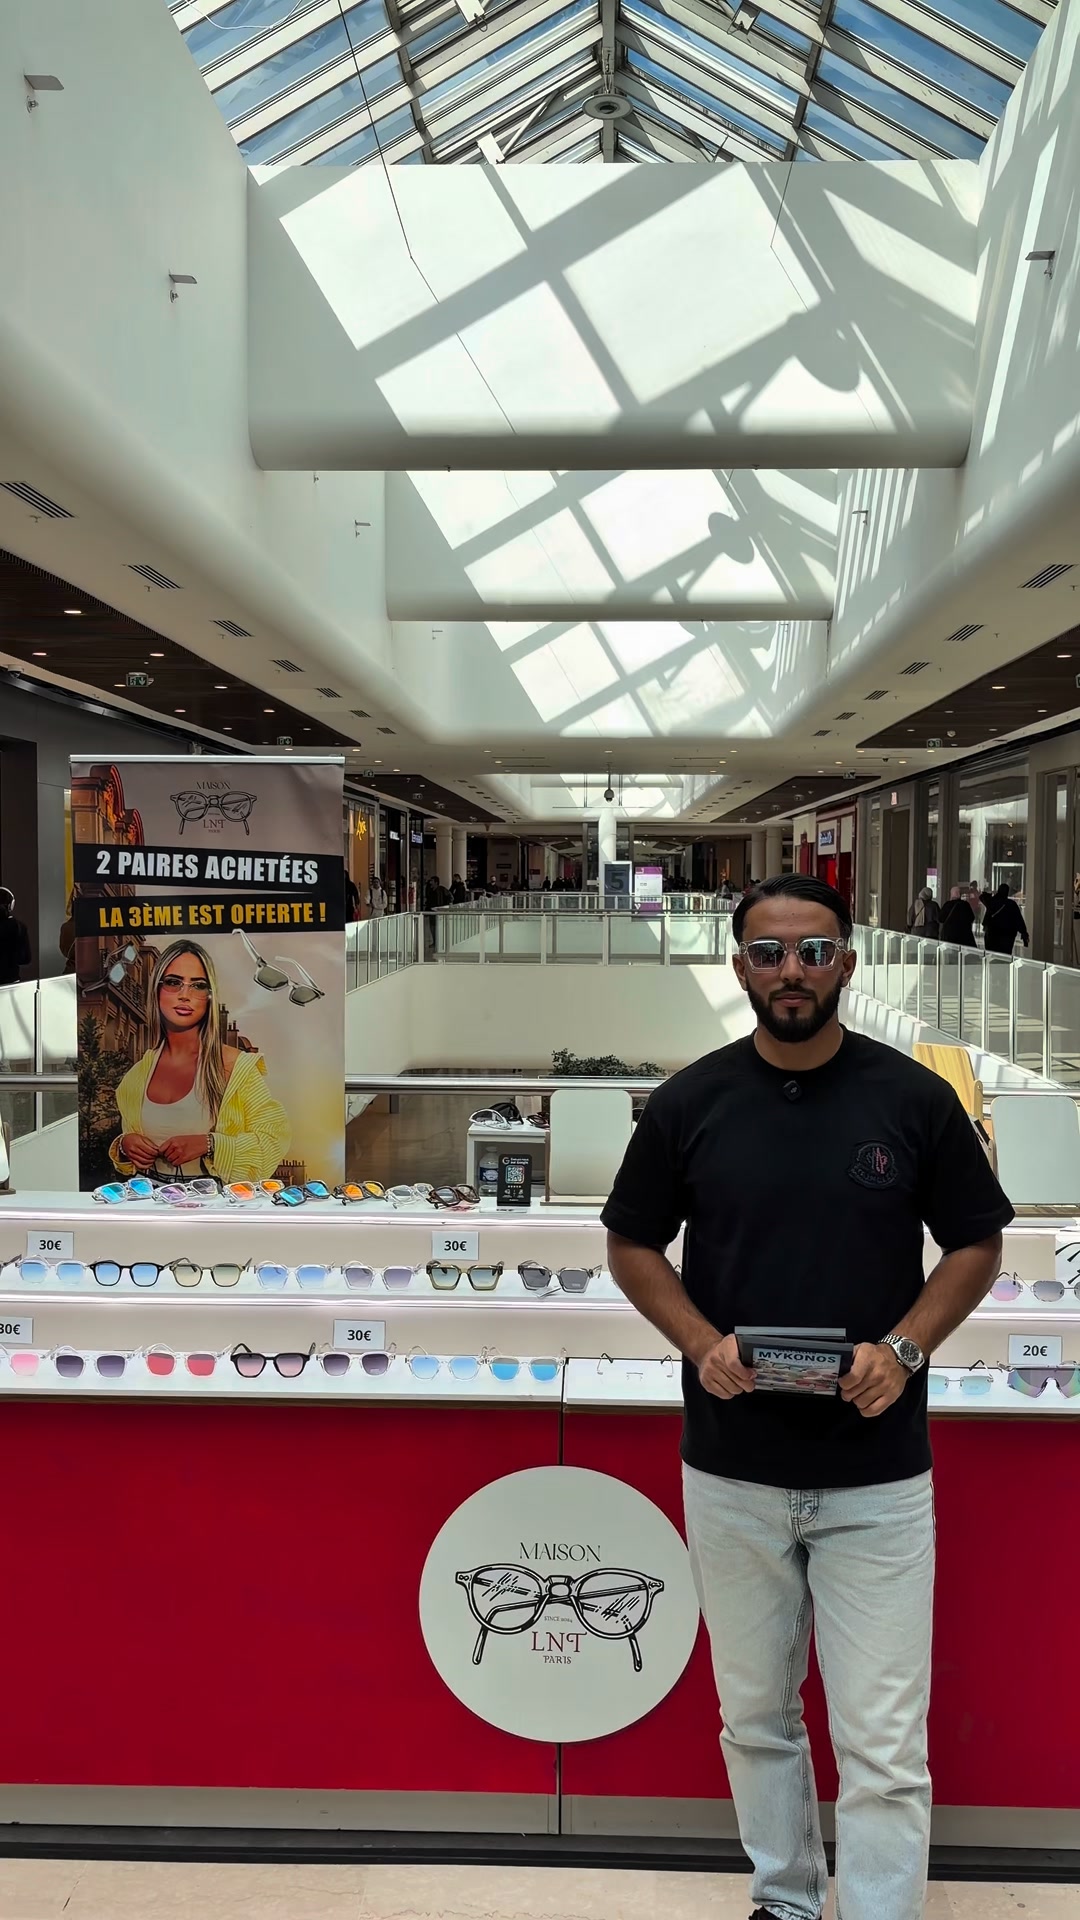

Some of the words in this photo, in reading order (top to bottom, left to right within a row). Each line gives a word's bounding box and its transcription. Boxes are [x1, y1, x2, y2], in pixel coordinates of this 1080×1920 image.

[196, 781, 231, 790] MAISON
[96, 850, 111, 875] 2
[118, 851, 199, 878] PAIRES
[204, 855, 319, 885] ACHETÉES
[99, 907, 124, 928] LA
[129, 902, 183, 927] 3ÈME
[189, 904, 225, 926] EST
[231, 902, 314, 925] OFFERTE
[319, 902, 327, 923] !
[39, 1239, 62, 1251] 30€
[444, 1240, 467, 1251] 30€
[0, 1323, 21, 1335] 30€
[347, 1329, 372, 1341] 30€
[1022, 1344, 1048, 1357] 20€
[758, 1351, 837, 1364] MYKONOS
[519, 1541, 601, 1562] MAISON
[531, 1631, 587, 1653] LNT
[543, 1655, 572, 1665] PARIS
